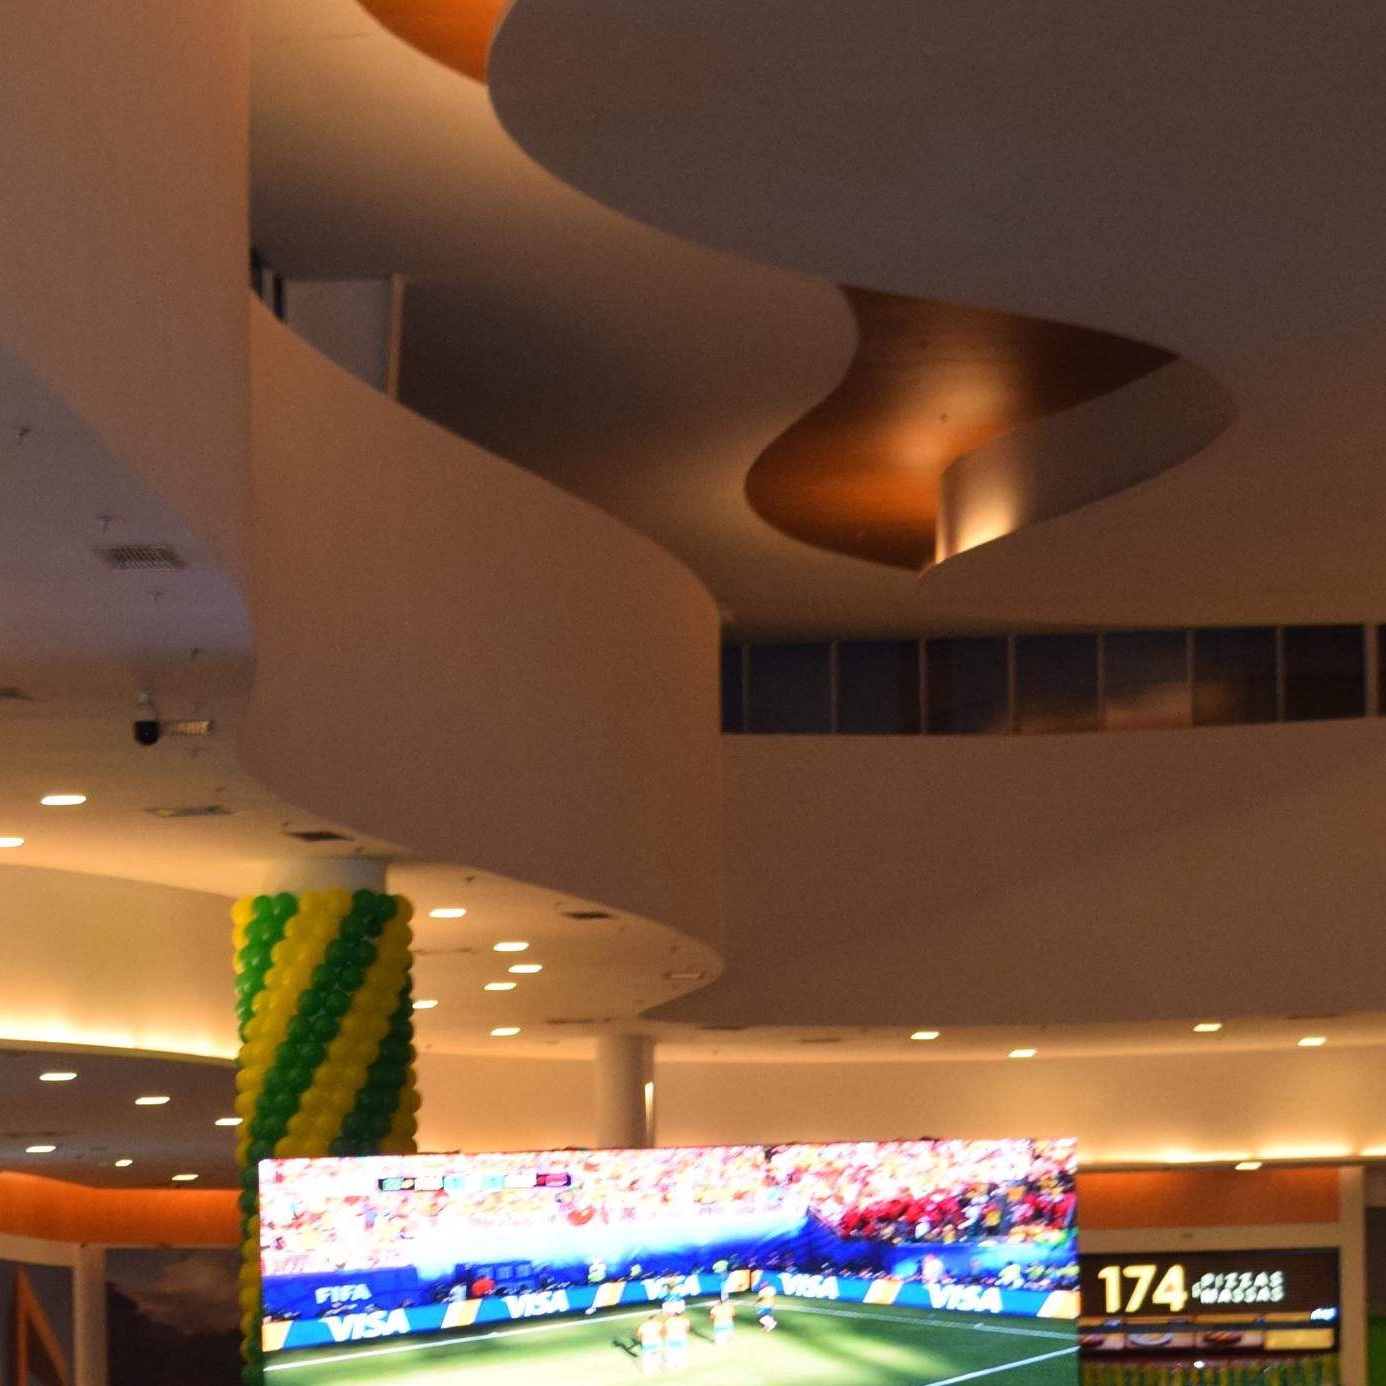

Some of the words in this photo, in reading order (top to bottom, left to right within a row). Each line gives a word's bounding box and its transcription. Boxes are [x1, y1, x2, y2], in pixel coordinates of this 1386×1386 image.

[315, 1284, 372, 1304] FIFA
[777, 1272, 840, 1299] VISA
[1097, 1264, 1188, 1313] 174
[1201, 1271, 1283, 1289] PIZZAS
[501, 1290, 569, 1319] VISA
[922, 1283, 1003, 1313] VISA
[1200, 1285, 1284, 1304] MASSAS
[318, 1308, 411, 1342] VISA
